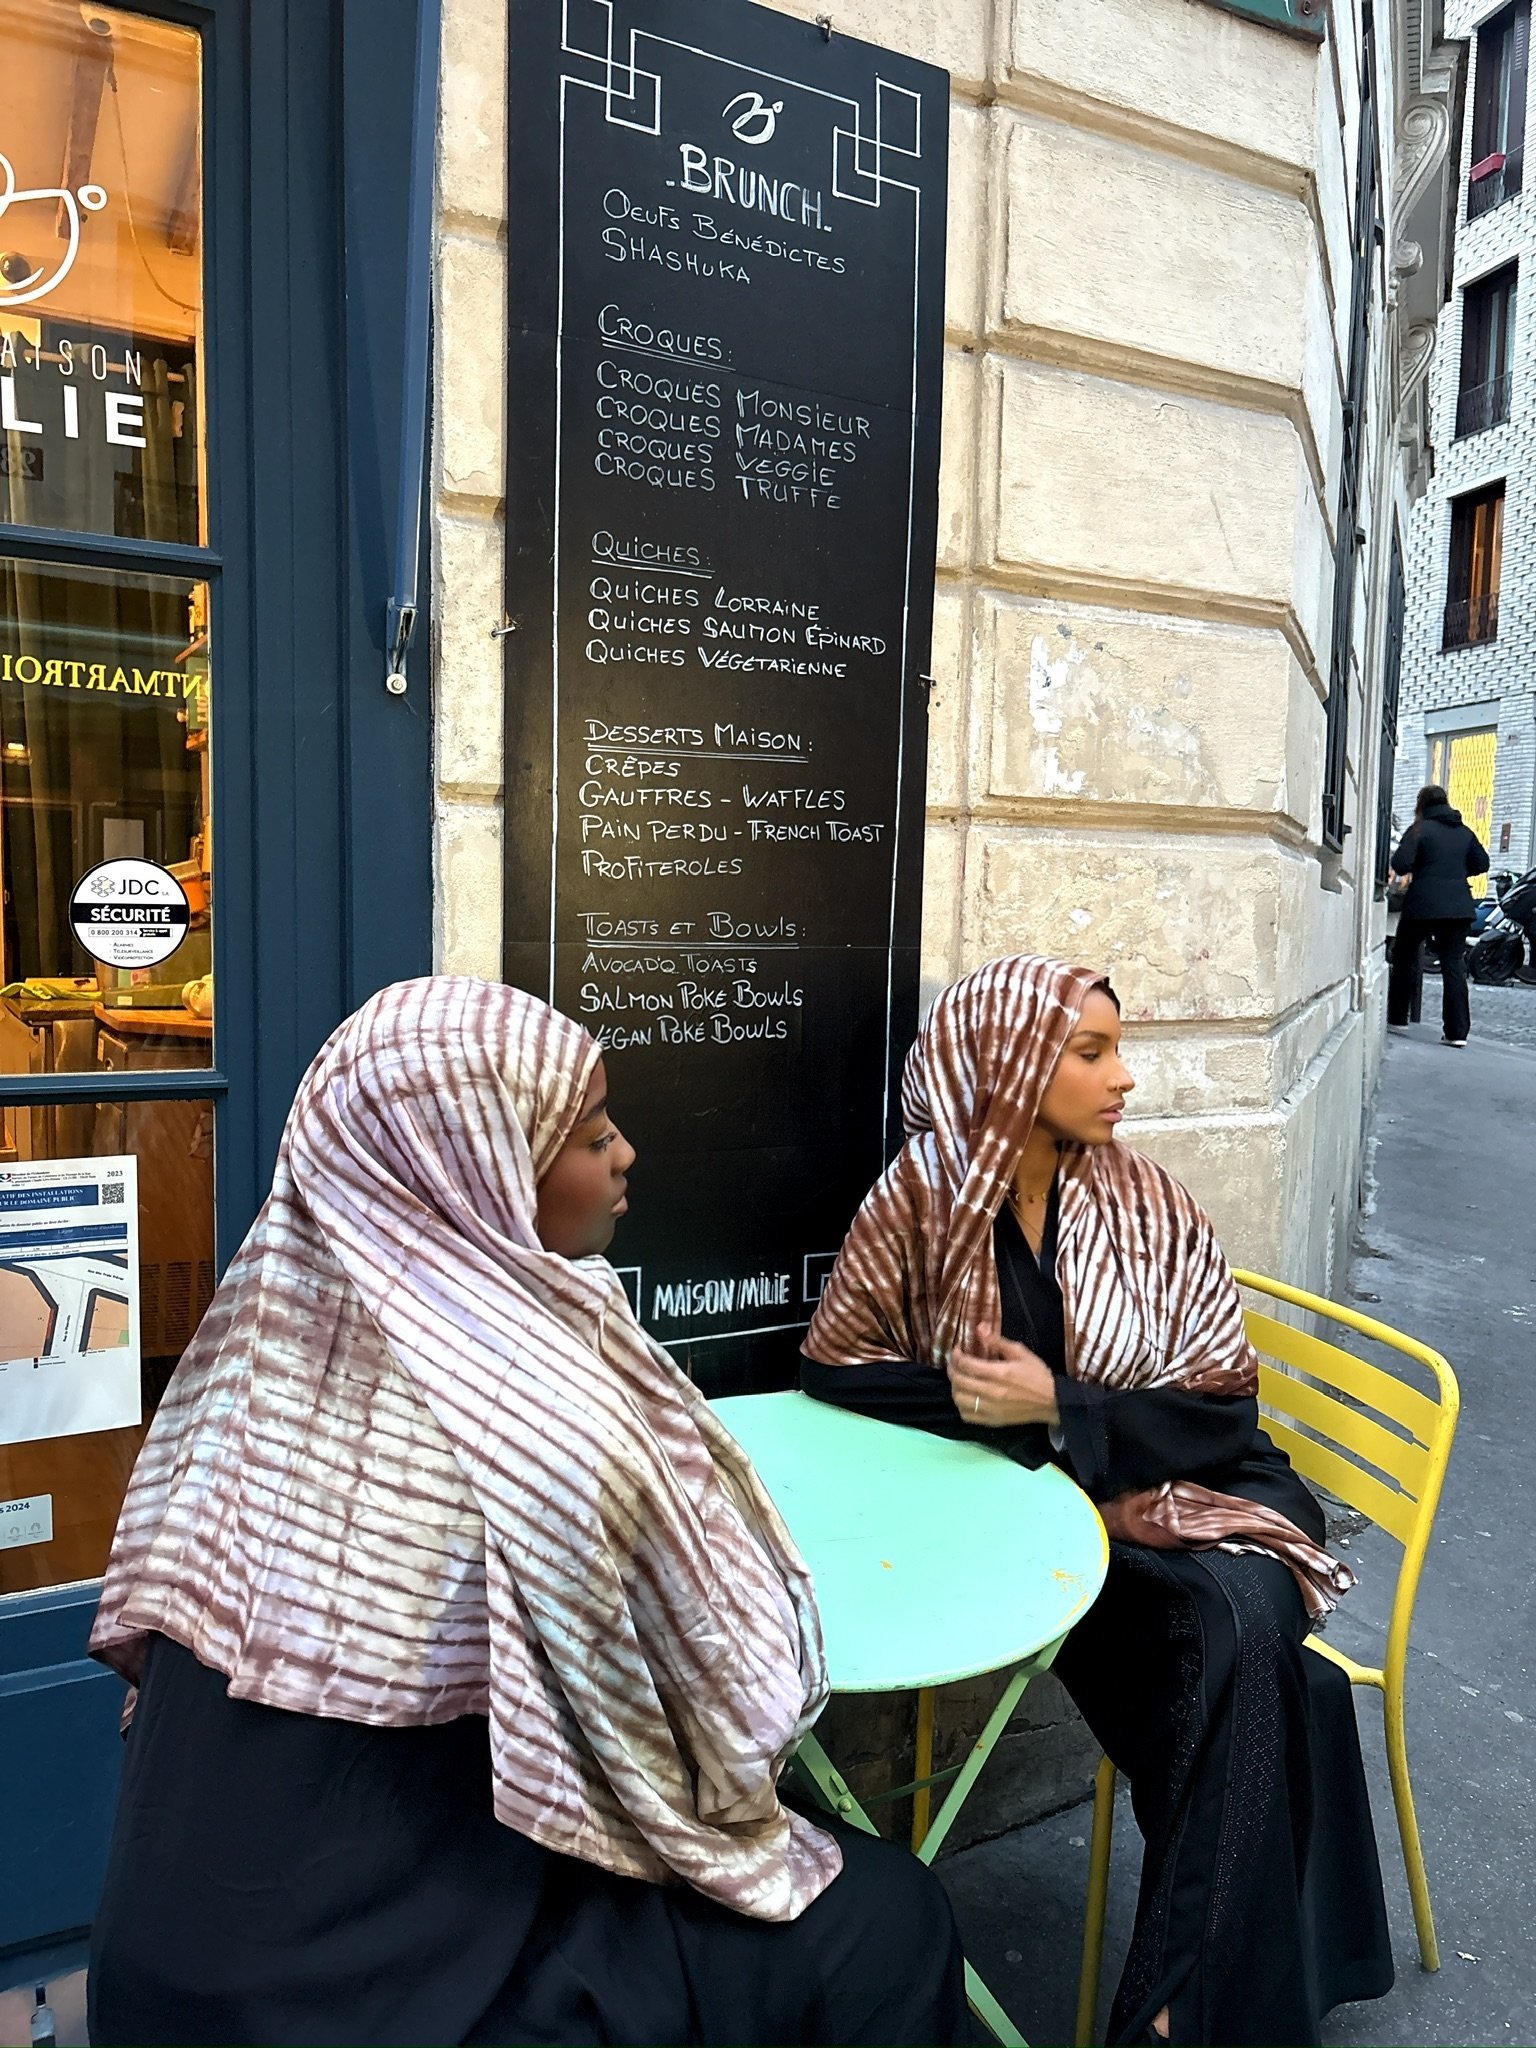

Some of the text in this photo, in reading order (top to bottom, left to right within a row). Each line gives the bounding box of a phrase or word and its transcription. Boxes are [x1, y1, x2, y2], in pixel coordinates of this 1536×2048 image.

[601, 227, 751, 285] SHASHUKA
[692, 213, 846, 274] BÉNÉDICTES
[596, 360, 871, 440] CROQUES MONSIEUR
[596, 395, 857, 463] CROQUES MADAMES
[597, 428, 836, 487] CROQUES VEGGIE
[594, 451, 841, 510] CROQUES TRUFFE
[589, 576, 820, 621] QUICHES LORRAINE
[588, 607, 887, 655] QUICHES SAUMON ÉPINARD
[585, 638, 847, 679] QUICHES VÉGÉTARIENNE
[582, 718, 704, 746] DESSERTS
[585, 754, 682, 780] CRÊPES
[578, 780, 712, 809] GAUFFRES
[742, 784, 846, 811] WAFFLES
[578, 814, 641, 843] PAIN
[647, 820, 728, 843] PERDU
[746, 819, 820, 843] FRENCH
[825, 820, 886, 844] TOAST
[580, 849, 744, 882] PROFITEROLES
[118, 879, 160, 896] JDC
[90, 905, 171, 922] SÉCURITÉ
[577, 911, 660, 937] TOASTS
[669, 922, 697, 936] ET
[679, 953, 758, 974] TOASTS
[579, 982, 674, 1013] SALMON
[5, 1501, 30, 1513] 2024
